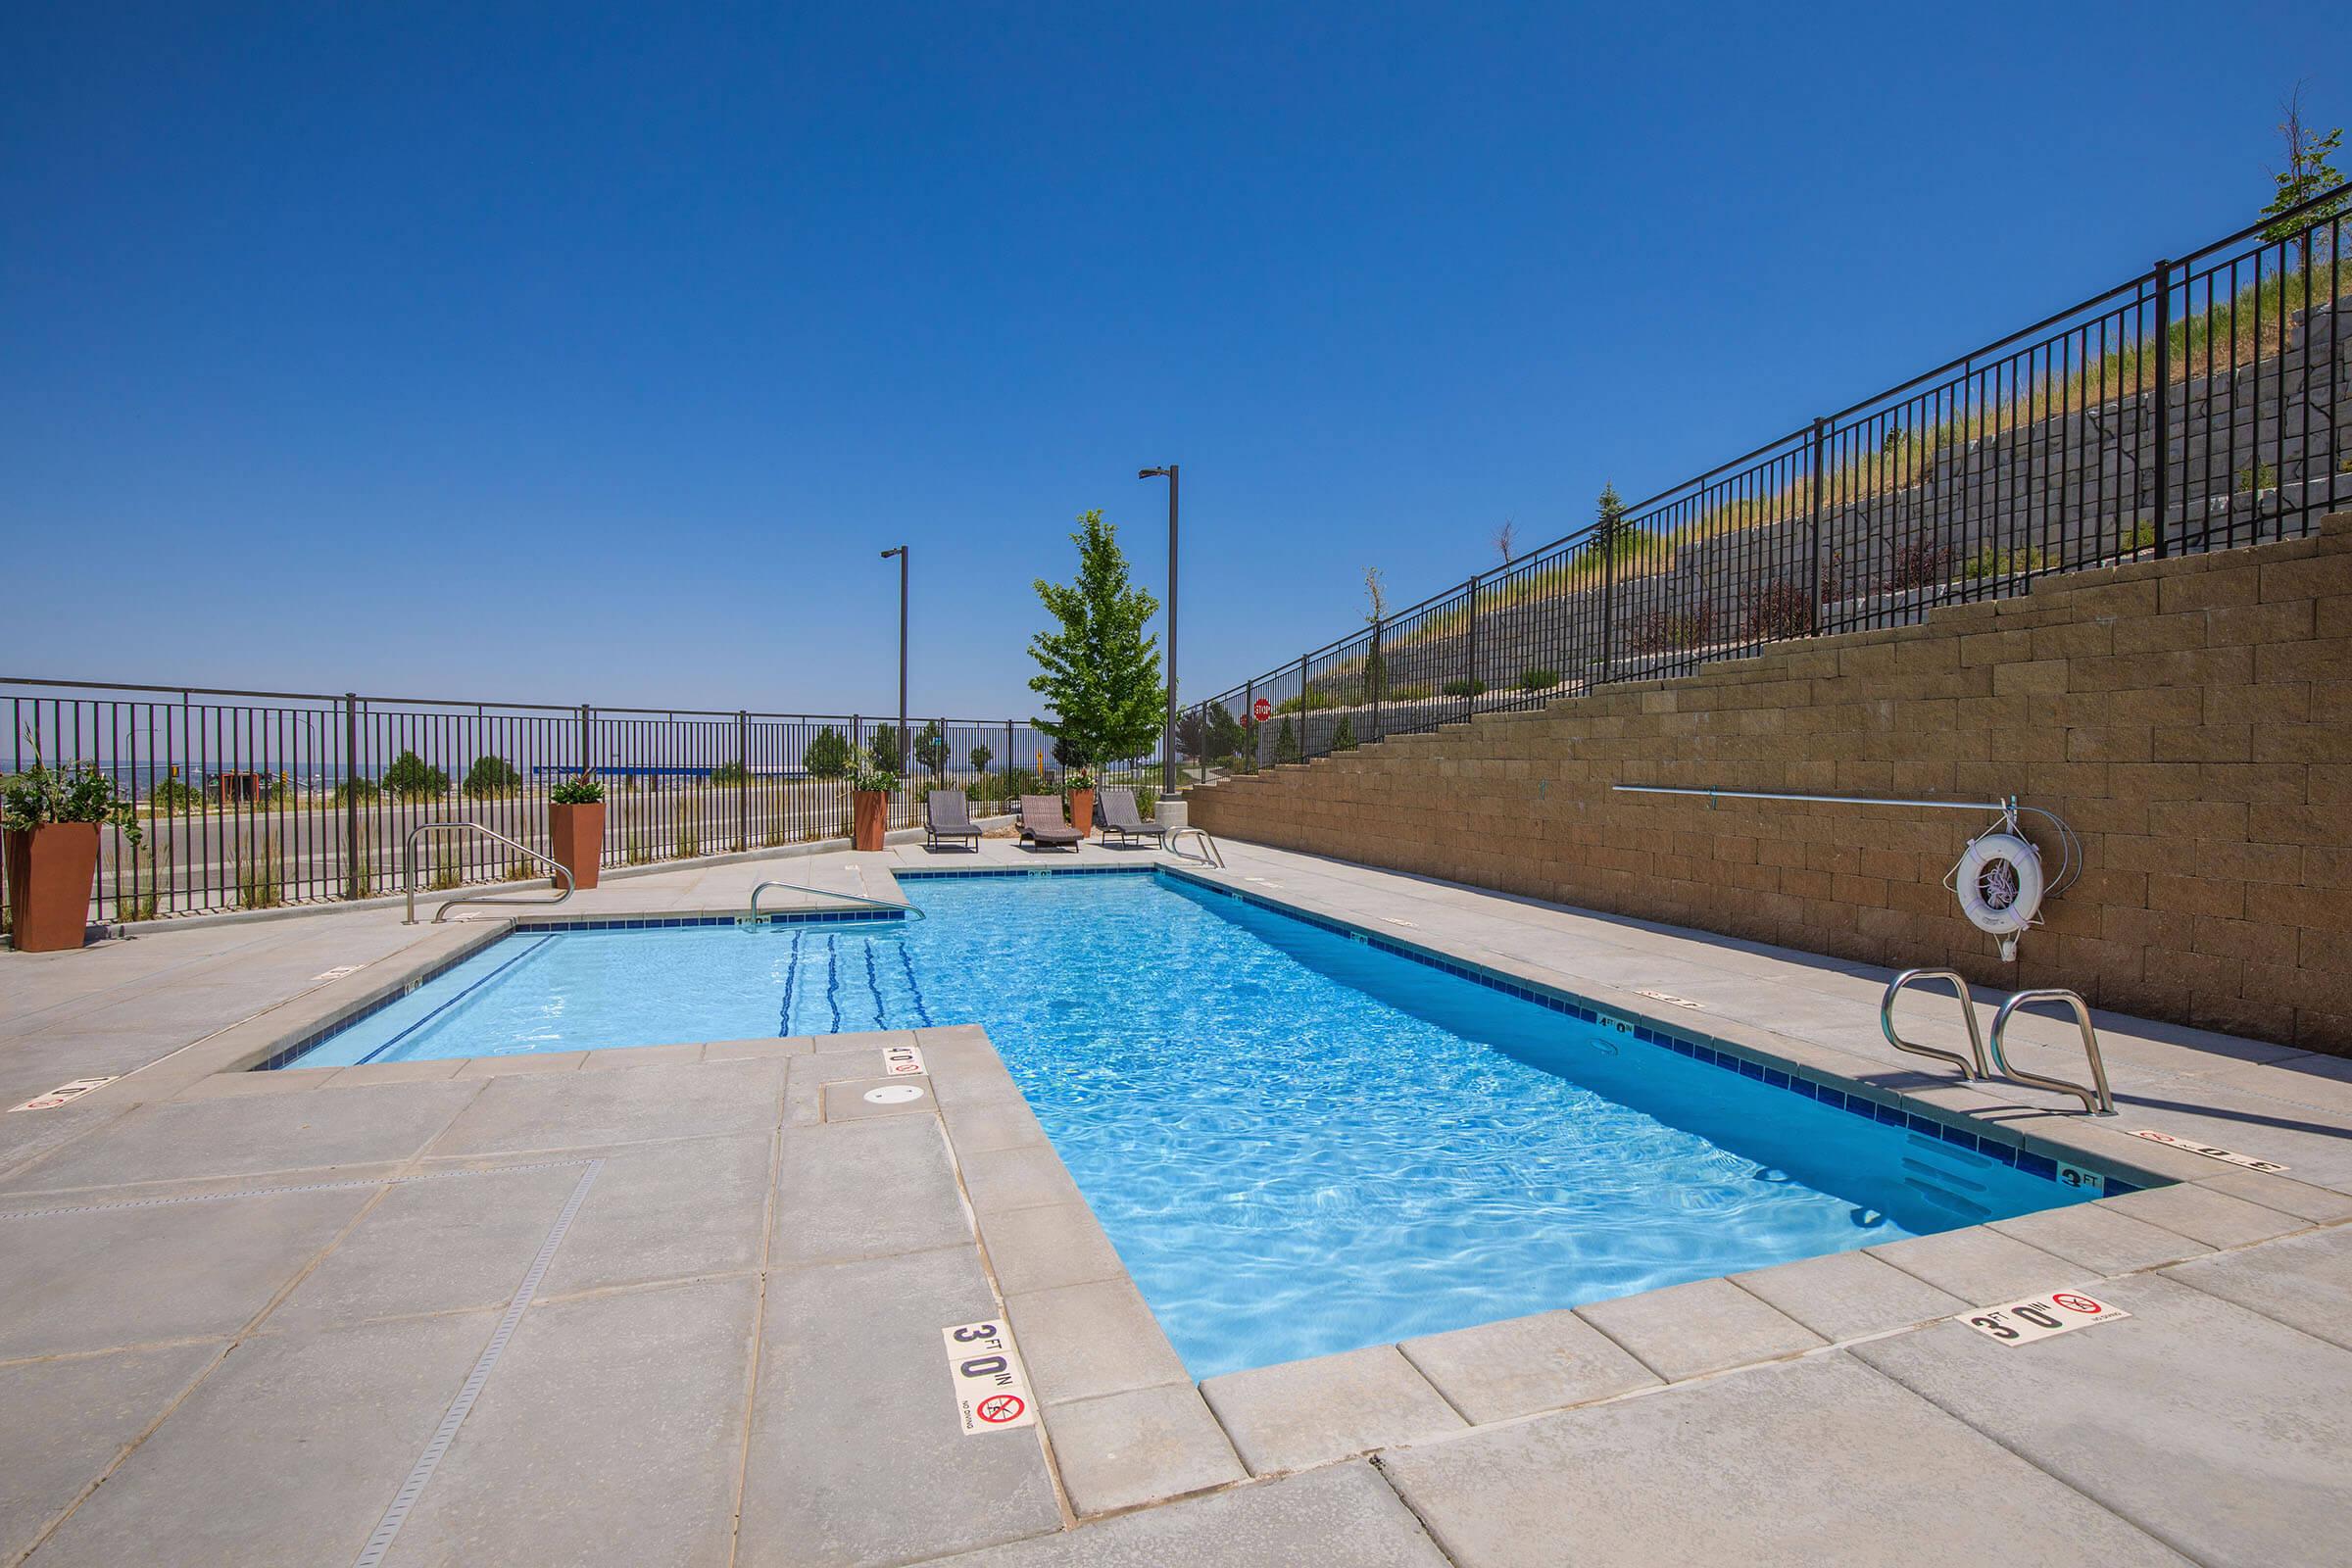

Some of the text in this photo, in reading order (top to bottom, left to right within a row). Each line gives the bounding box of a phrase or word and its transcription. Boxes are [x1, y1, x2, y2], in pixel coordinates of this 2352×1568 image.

[1254, 705, 1271, 714] STOP
[1617, 1022, 1626, 1033] 0
[2061, 1168, 2098, 1188] 3 FT
[1971, 1301, 2063, 1339] 3 FT 0 IN
[954, 1324, 1013, 1386] 3 FT 0 IN
[962, 1399, 974, 1430] NO DIVING
